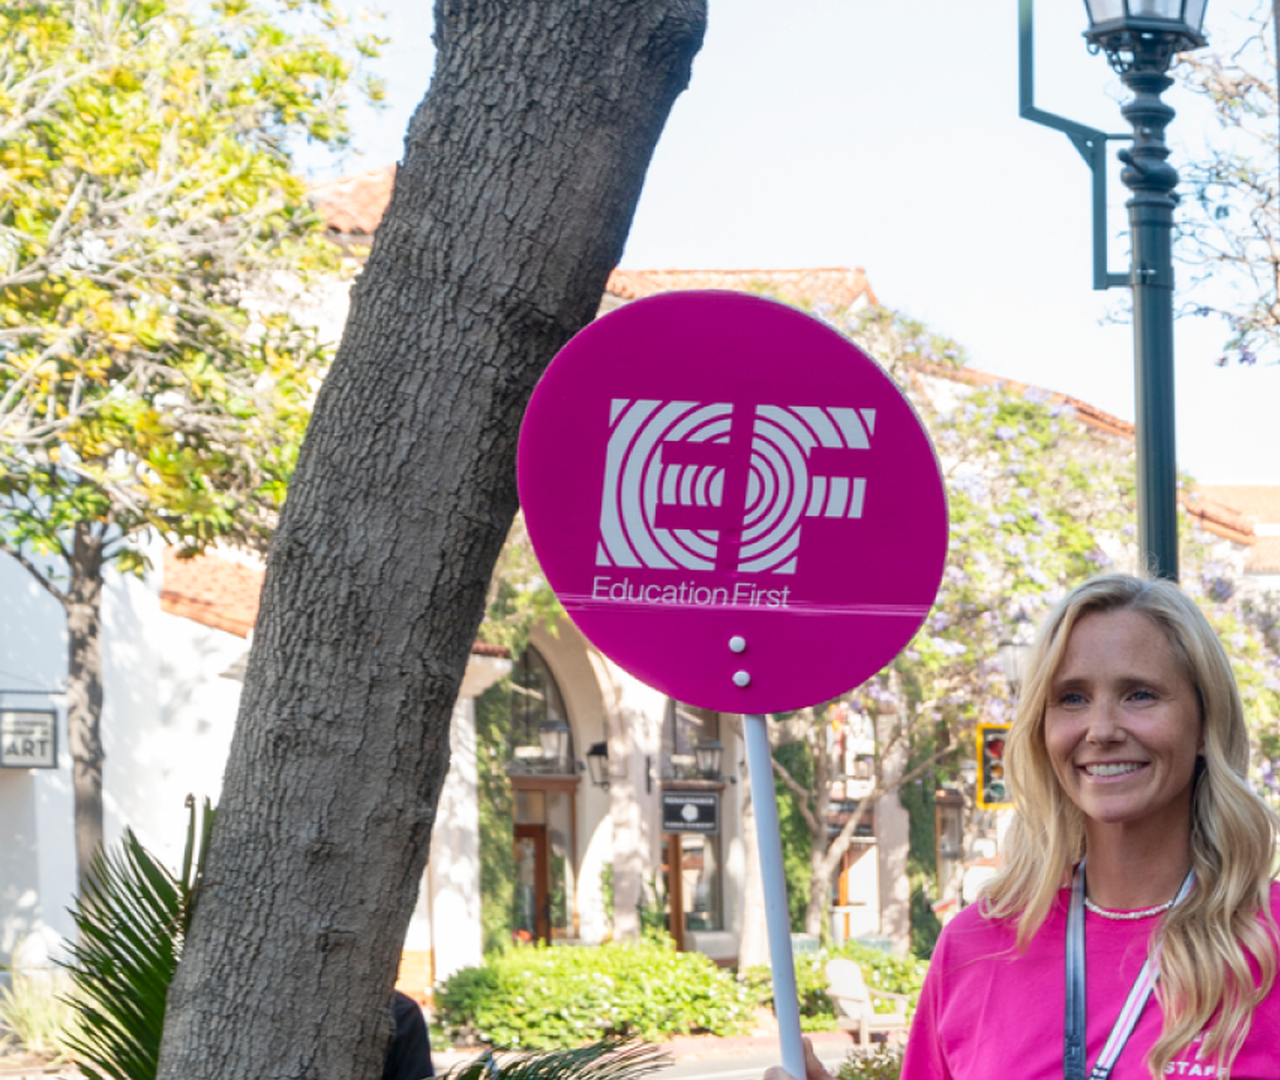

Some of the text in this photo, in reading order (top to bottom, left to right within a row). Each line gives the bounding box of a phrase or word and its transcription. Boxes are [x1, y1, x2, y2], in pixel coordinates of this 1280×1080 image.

[595, 398, 877, 575] EF
[590, 576, 792, 609] Education First
[5, 738, 49, 757] ART
